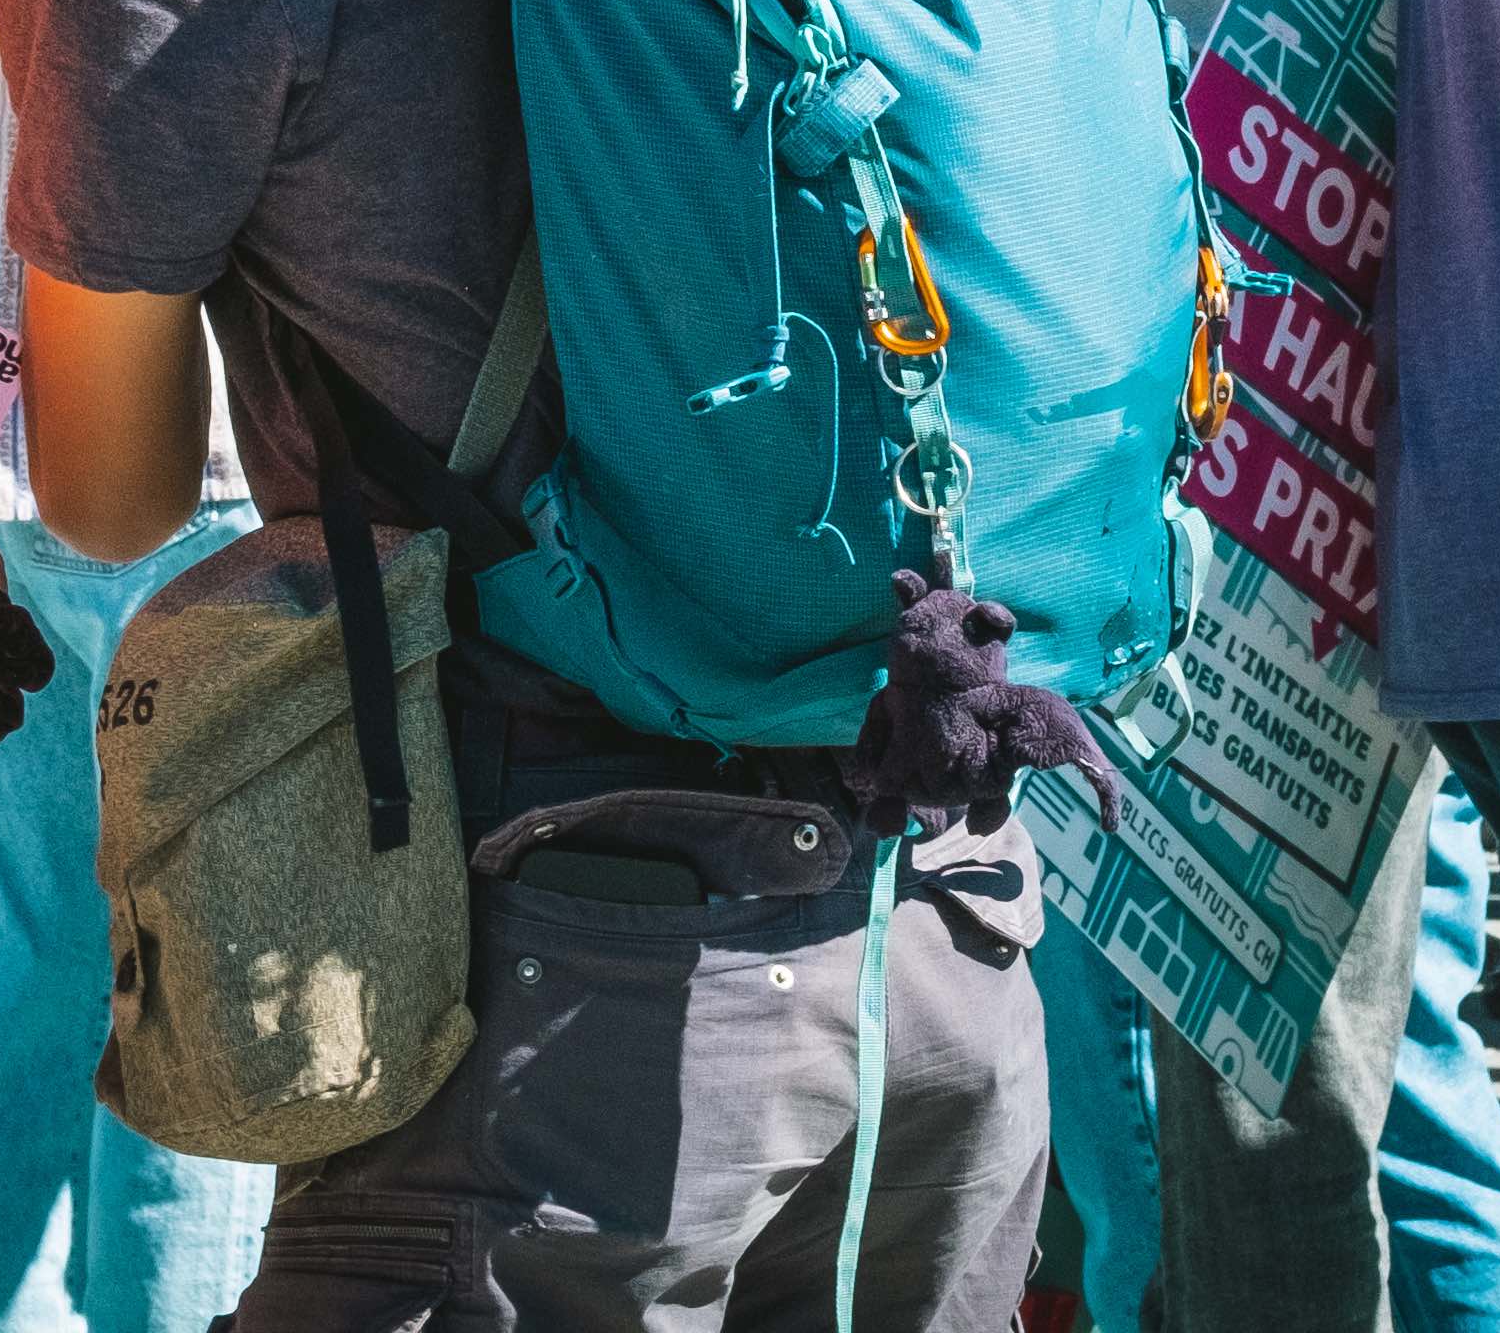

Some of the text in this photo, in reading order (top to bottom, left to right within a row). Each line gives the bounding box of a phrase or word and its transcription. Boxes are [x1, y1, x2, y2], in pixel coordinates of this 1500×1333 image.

[1228, 103, 1391, 272] STOP
[1198, 418, 1250, 499] S
[1144, 679, 1334, 831] BLCS GRATUITS
[1182, 649, 1366, 806] DES TRANSPORTS
[1194, 610, 1374, 762] EZ L'INITIATIVE
